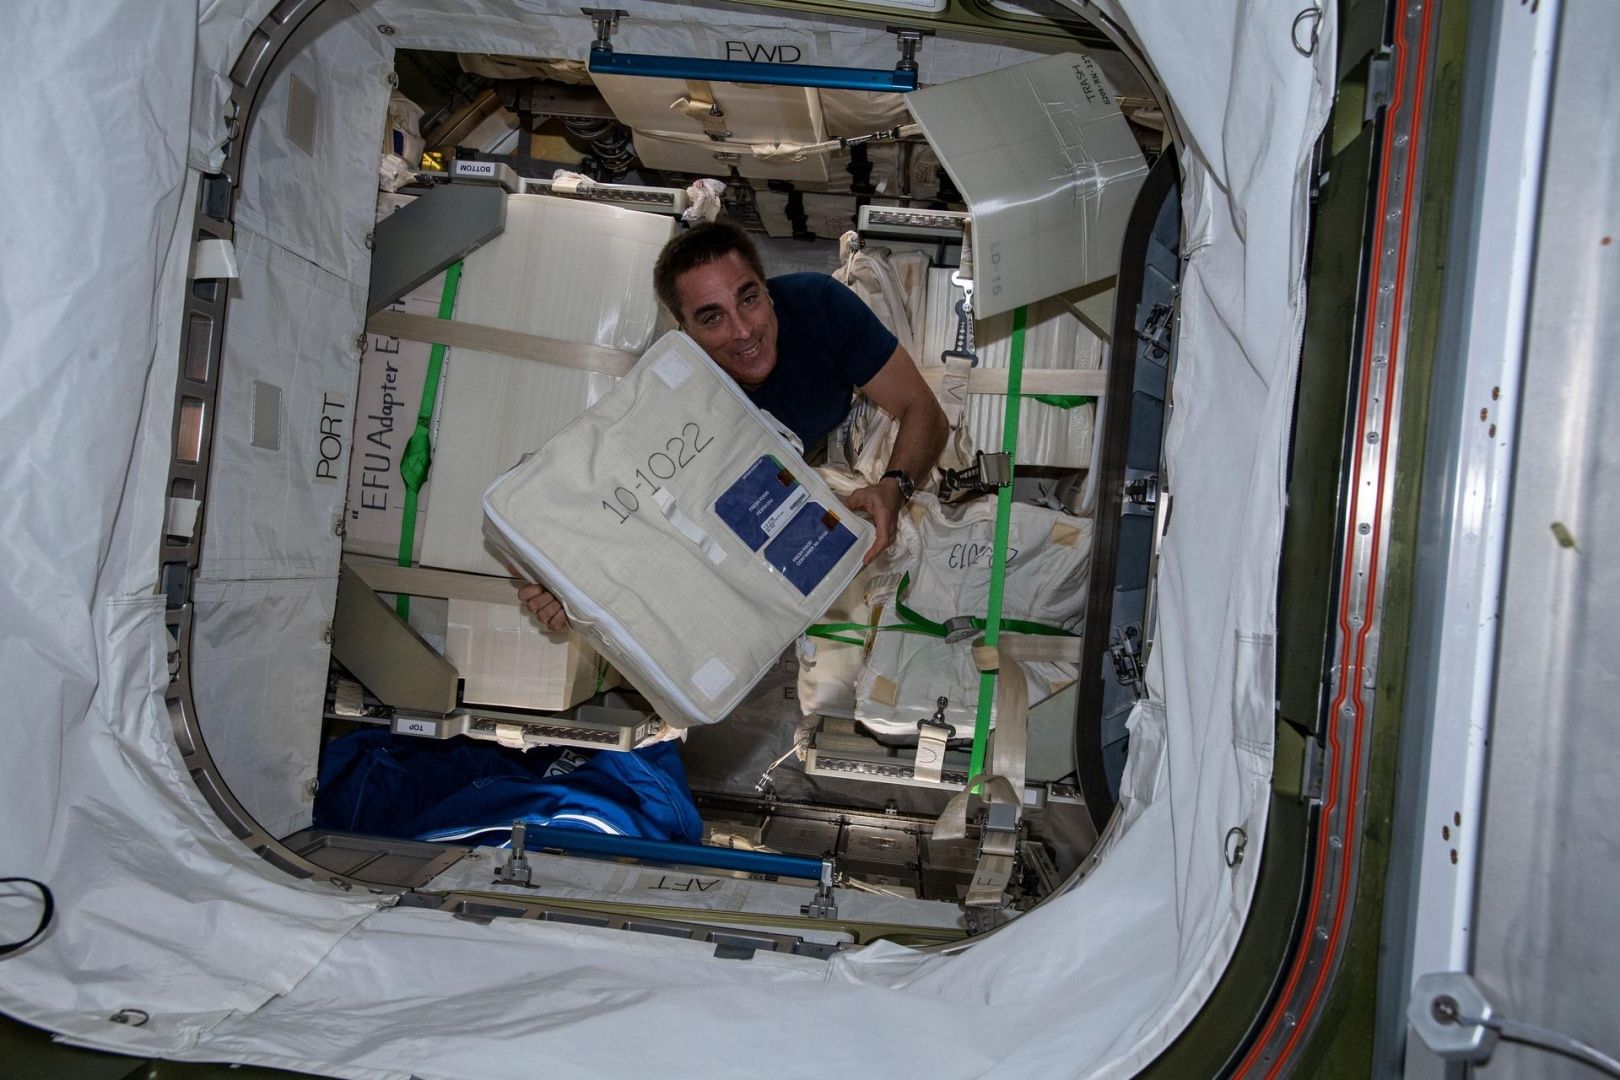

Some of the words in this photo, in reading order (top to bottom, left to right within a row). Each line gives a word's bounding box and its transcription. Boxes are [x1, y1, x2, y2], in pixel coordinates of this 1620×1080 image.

[725, 41, 801, 62] FWD
[1072, 64, 1096, 104] TRASH
[460, 164, 491, 173] BOTTOM
[366, 361, 405, 450] Adapter
[316, 392, 345, 479] PORT
[602, 422, 714, 524] 10-1022
[408, 723, 424, 732] TOP
[648, 876, 720, 891] AFT
